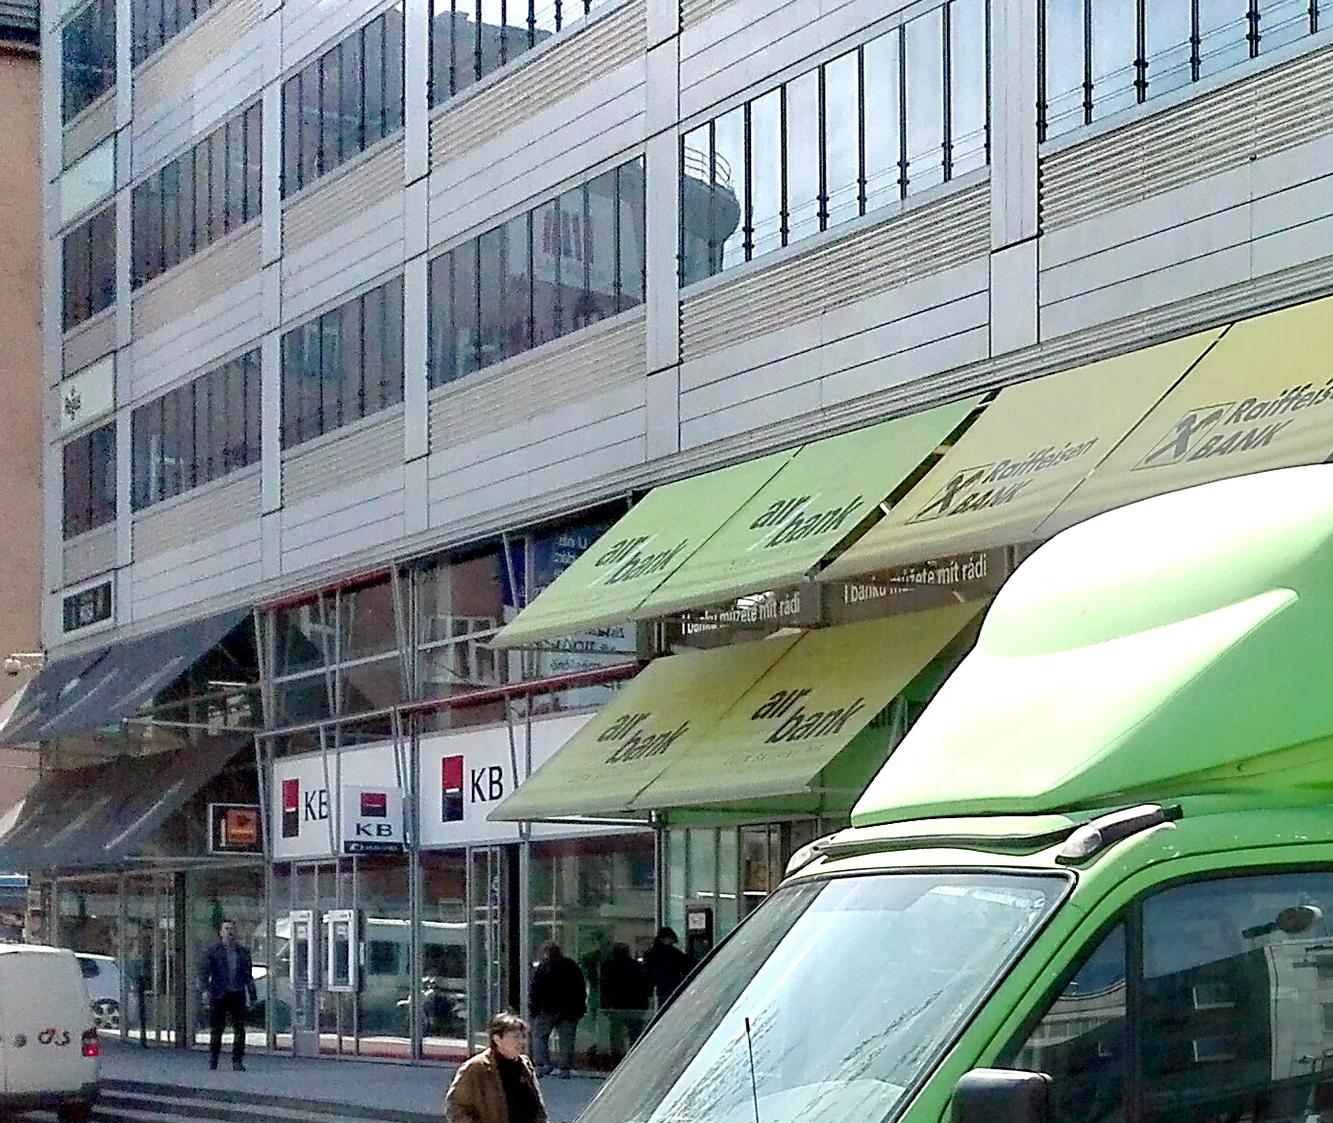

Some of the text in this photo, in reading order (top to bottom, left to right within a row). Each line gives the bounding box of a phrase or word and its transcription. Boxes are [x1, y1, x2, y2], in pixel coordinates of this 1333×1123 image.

[1187, 419, 1295, 462] BANK
[750, 494, 812, 530] air
[947, 479, 1034, 517] BANK
[764, 494, 865, 549] bank
[962, 553, 987, 580] rádi
[751, 687, 813, 721] air
[764, 697, 866, 744] bank
[597, 712, 652, 742] air
[605, 720, 690, 764] bank
[470, 765, 503, 803] KB
[355, 823, 393, 837] KB
